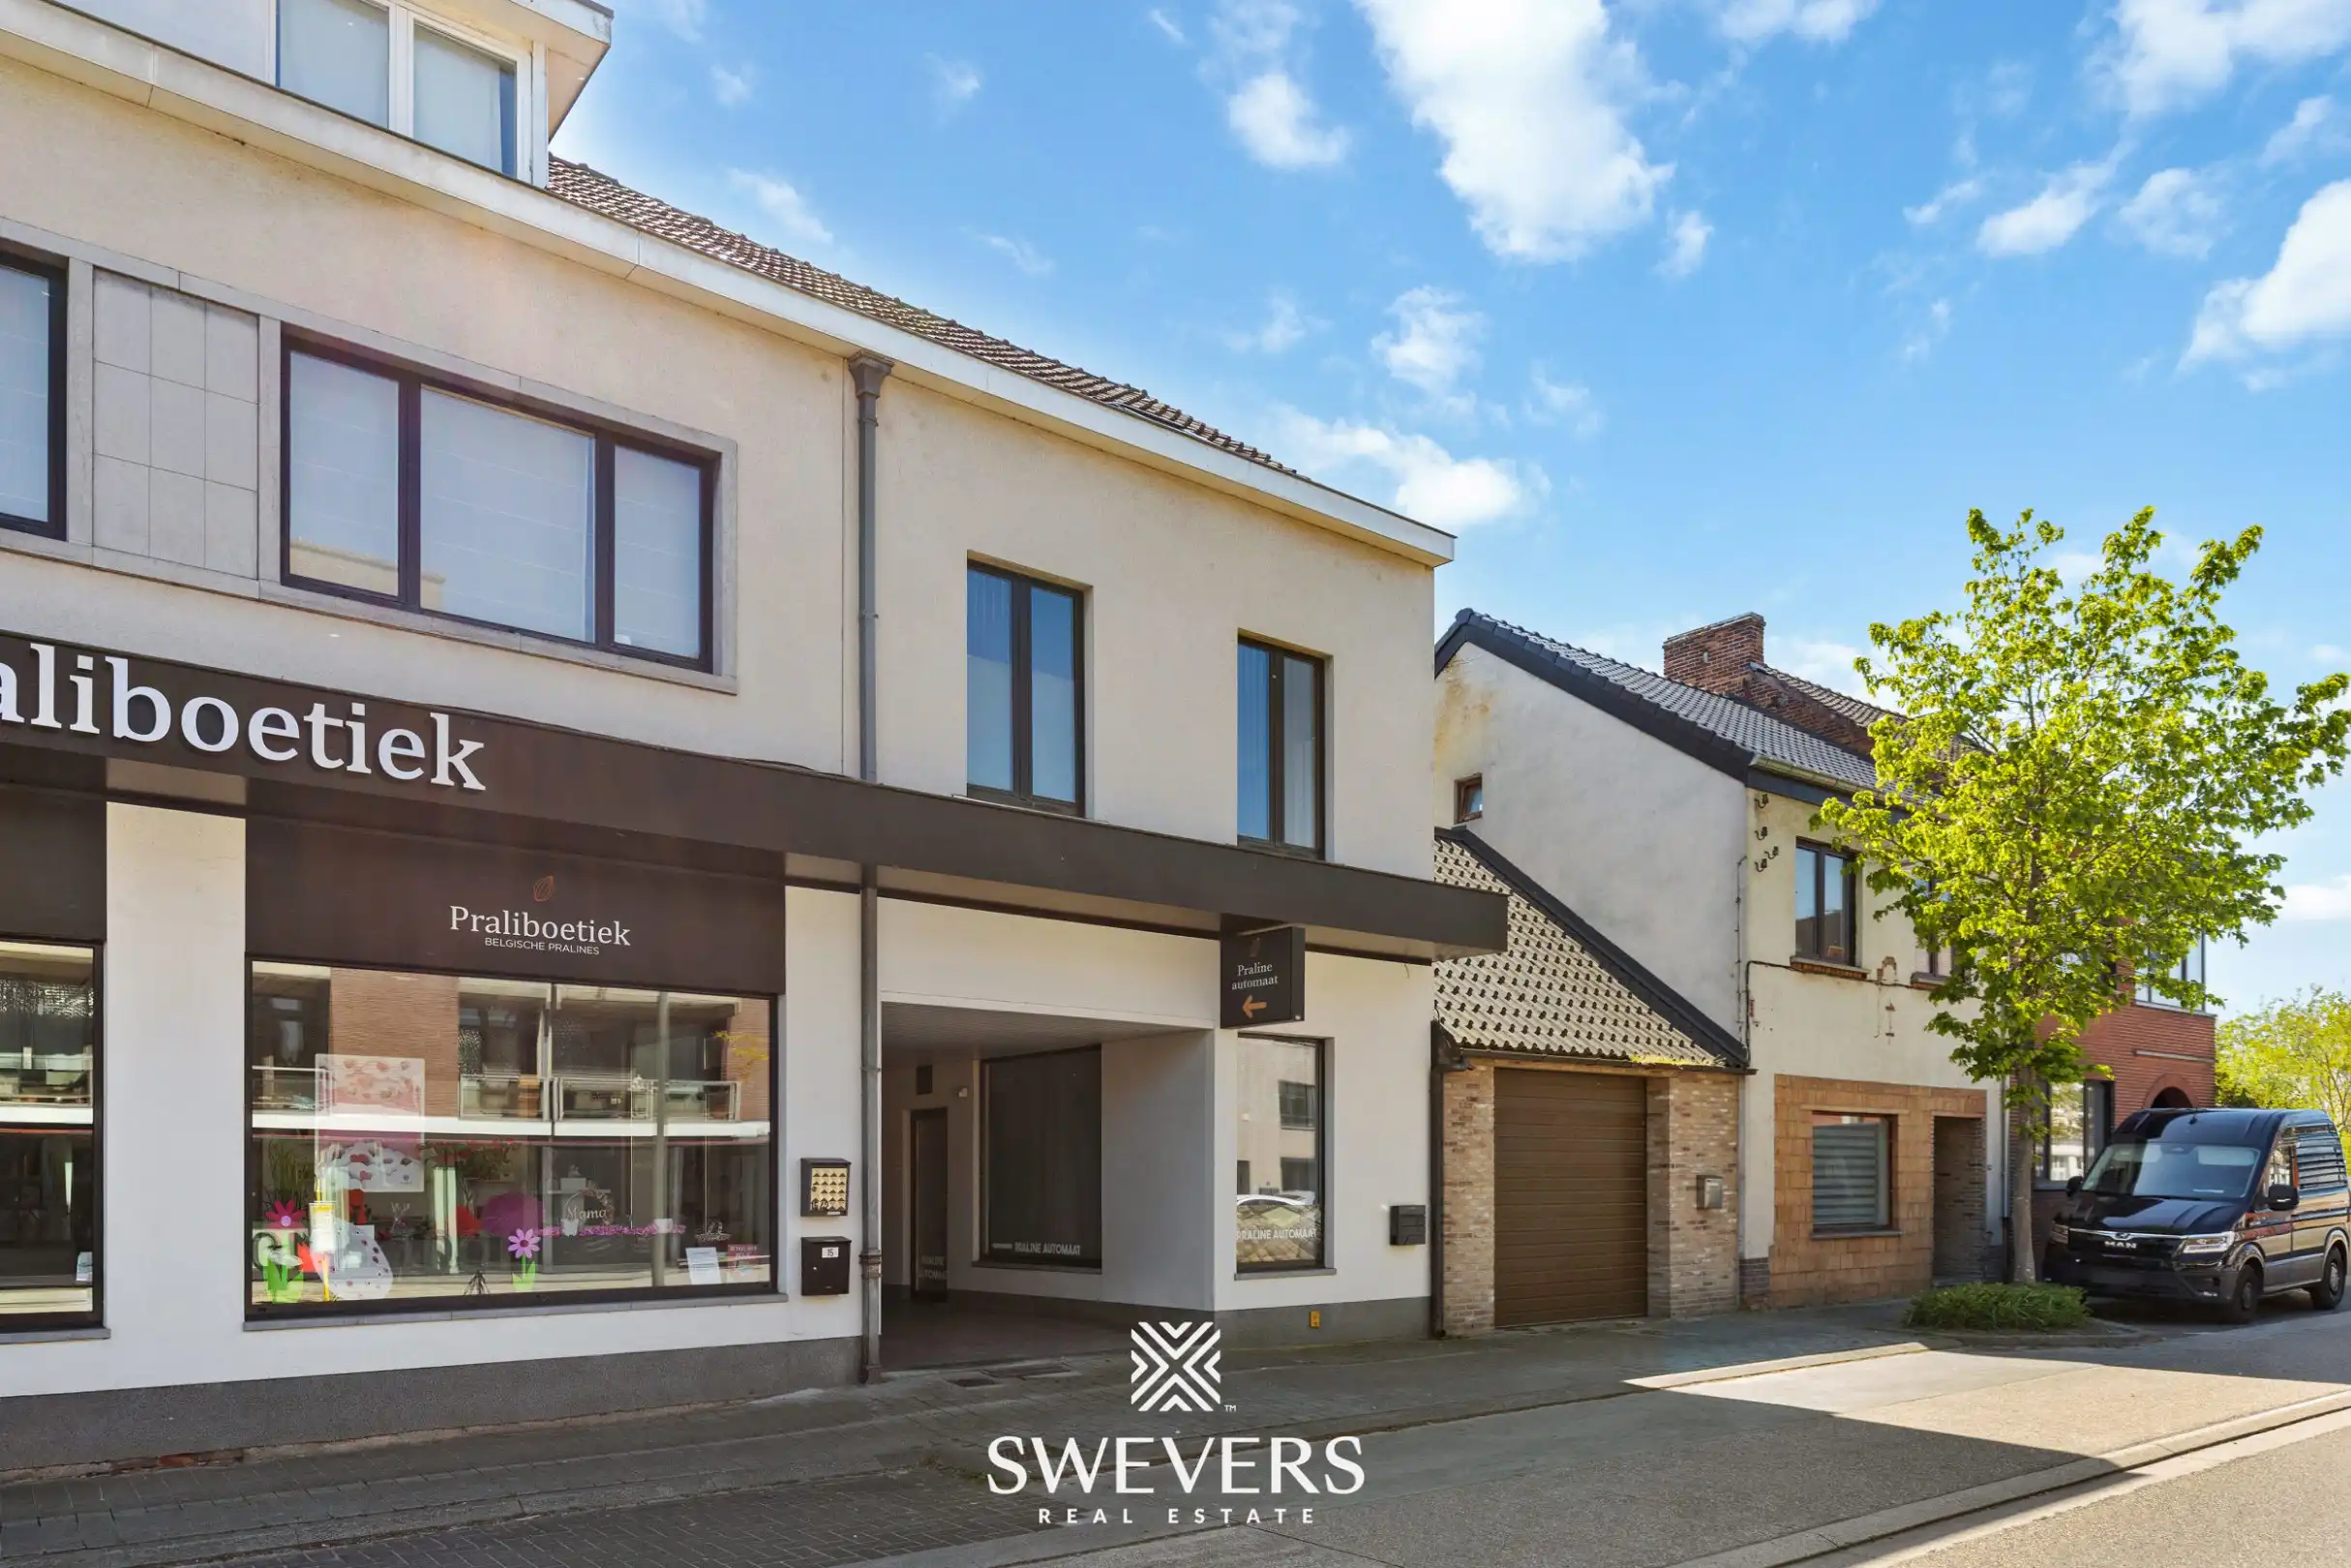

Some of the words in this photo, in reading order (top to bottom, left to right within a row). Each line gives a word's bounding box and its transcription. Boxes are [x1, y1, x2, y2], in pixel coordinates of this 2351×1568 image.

[449, 905, 631, 946] Praliboetiek
[485, 937, 545, 951] BELGISCHE
[548, 943, 600, 955] PRALINES
[1237, 961, 1273, 977] Praline
[1231, 976, 1278, 990] automaat
[1236, 1228, 1272, 1240] PRALINE
[1273, 1227, 1316, 1239] AUTOMAAT
[2104, 1241, 2137, 1250] MAN
